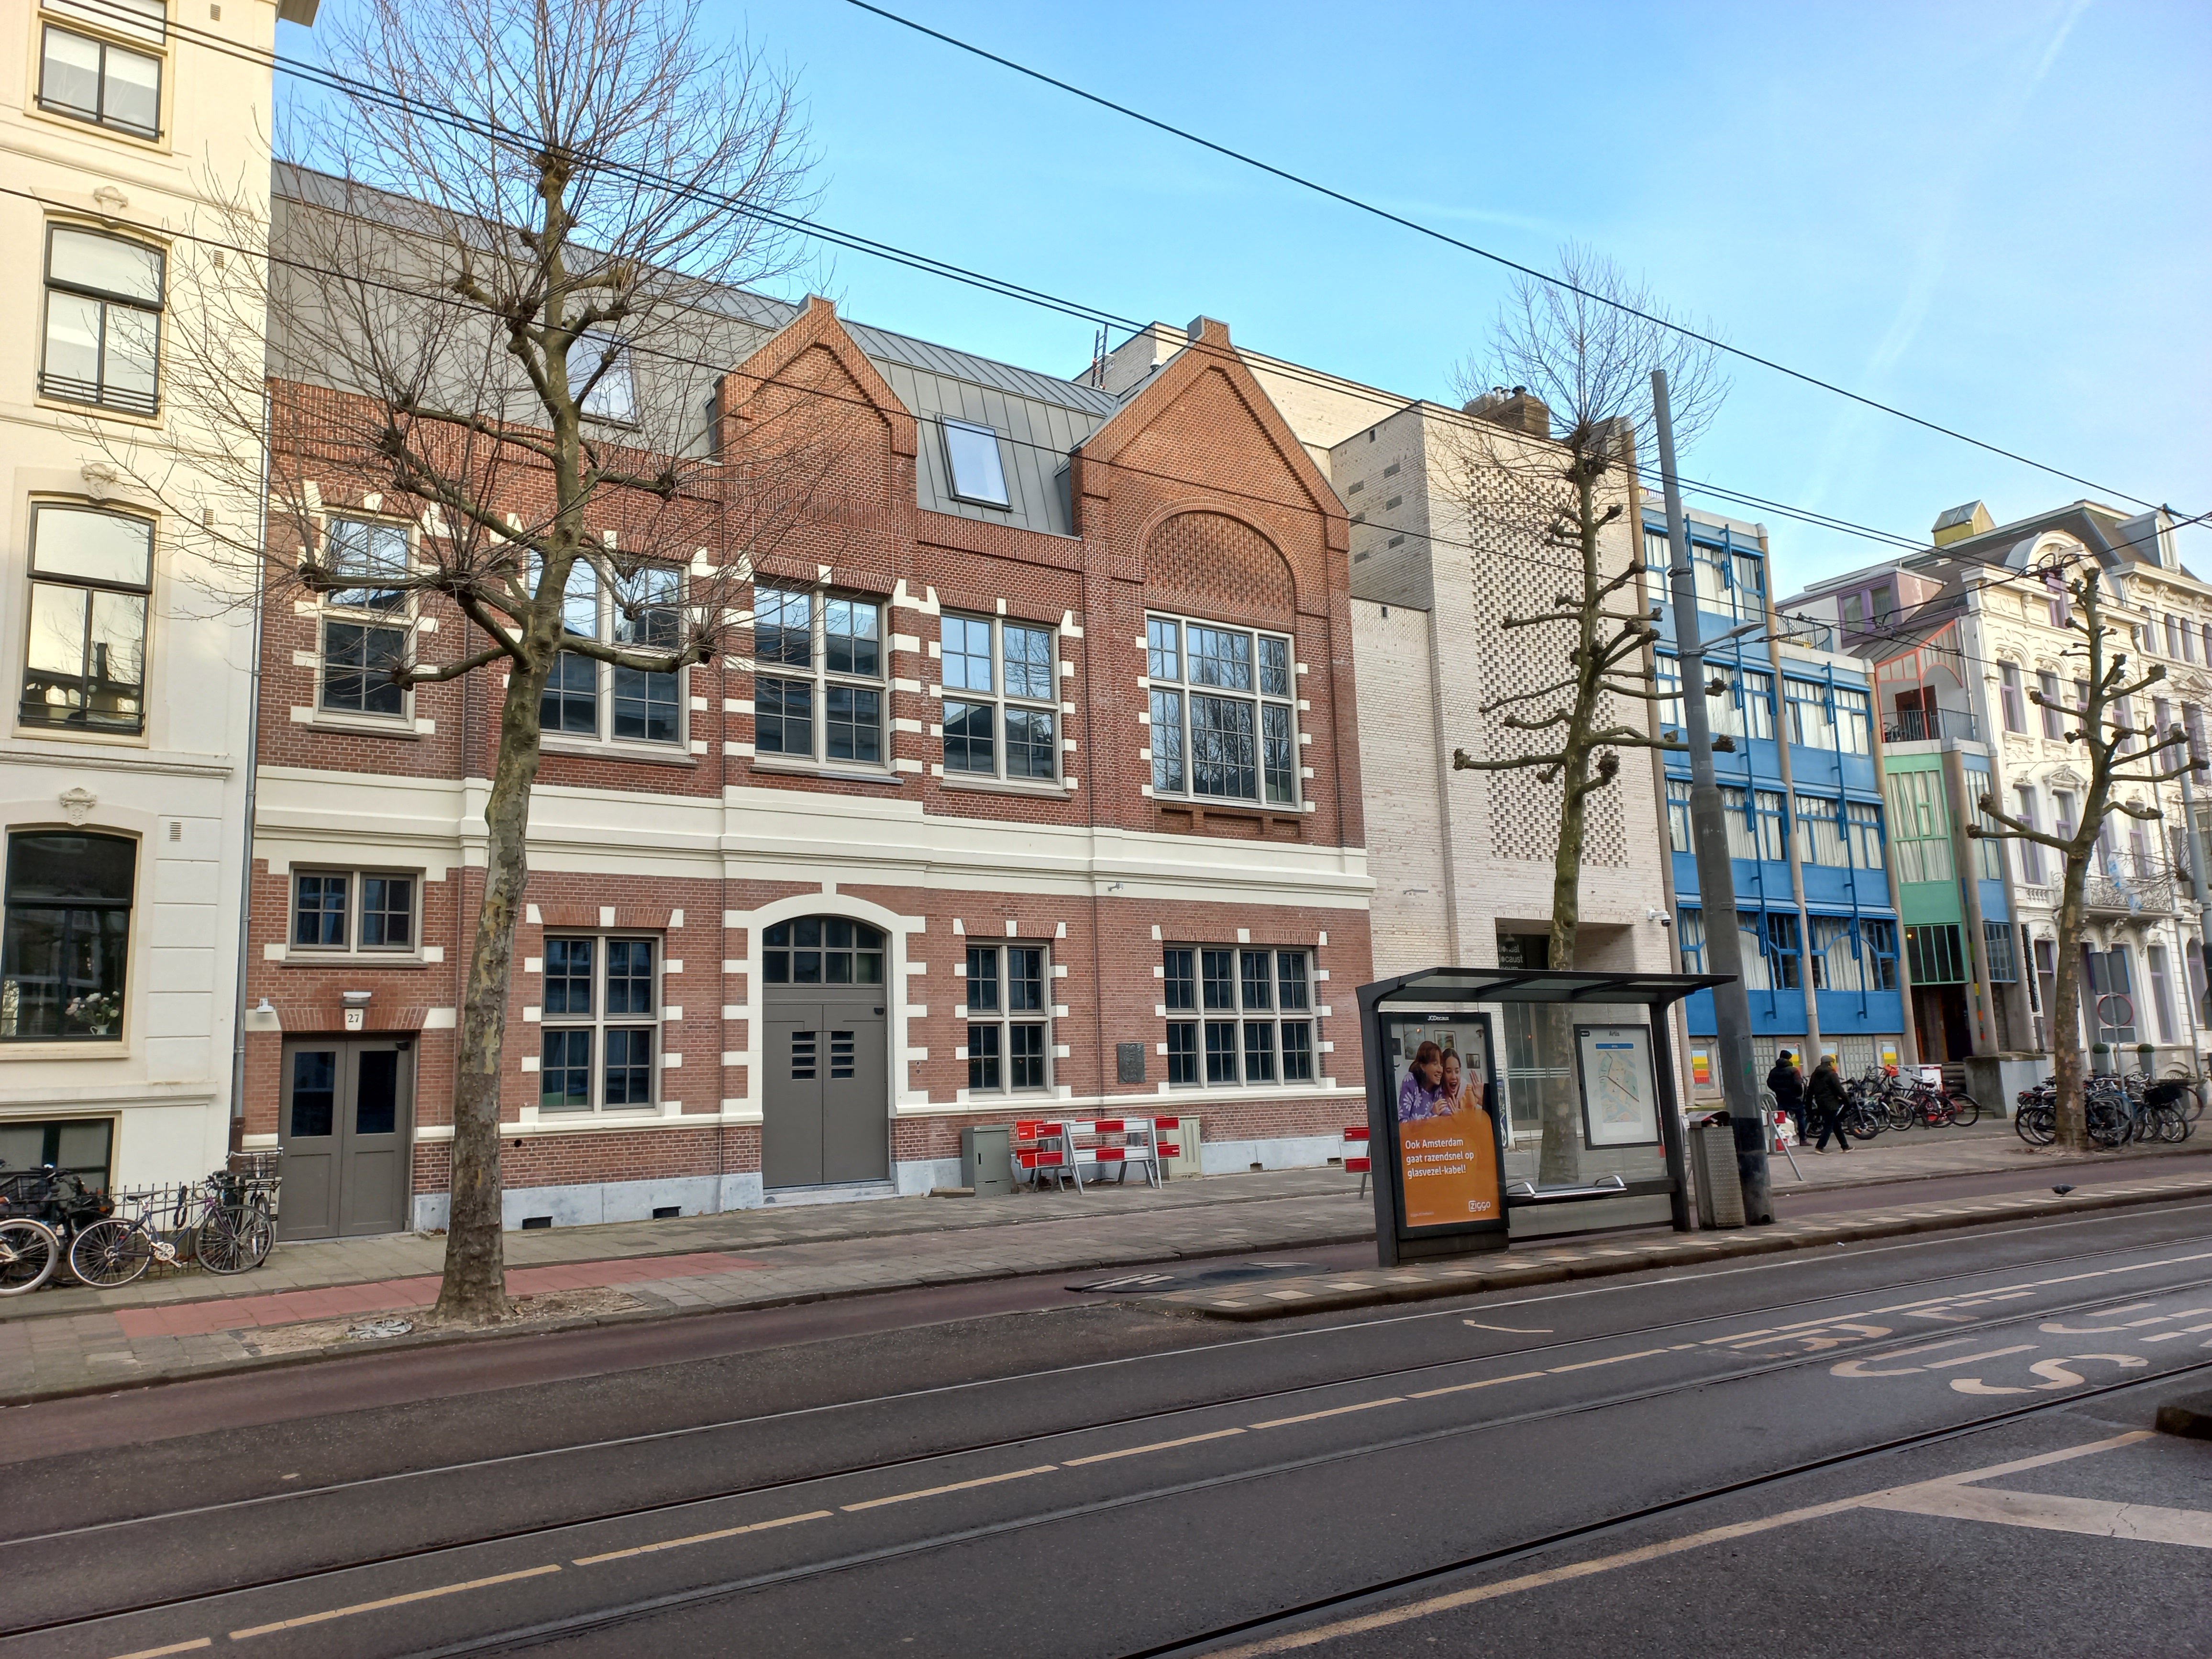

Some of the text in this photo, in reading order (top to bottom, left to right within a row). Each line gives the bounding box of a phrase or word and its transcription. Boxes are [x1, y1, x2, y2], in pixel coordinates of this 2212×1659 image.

[1499, 954, 1524, 963] locaust
[347, 1014, 360, 1023] 27
[1405, 1138, 1464, 1150] Ook Amsterdam
[1406, 1150, 1474, 1166] gaat razendsnel op
[1407, 1164, 1466, 1180] glasvezel-kabel!
[1695, 1323, 2149, 1395] BUS
